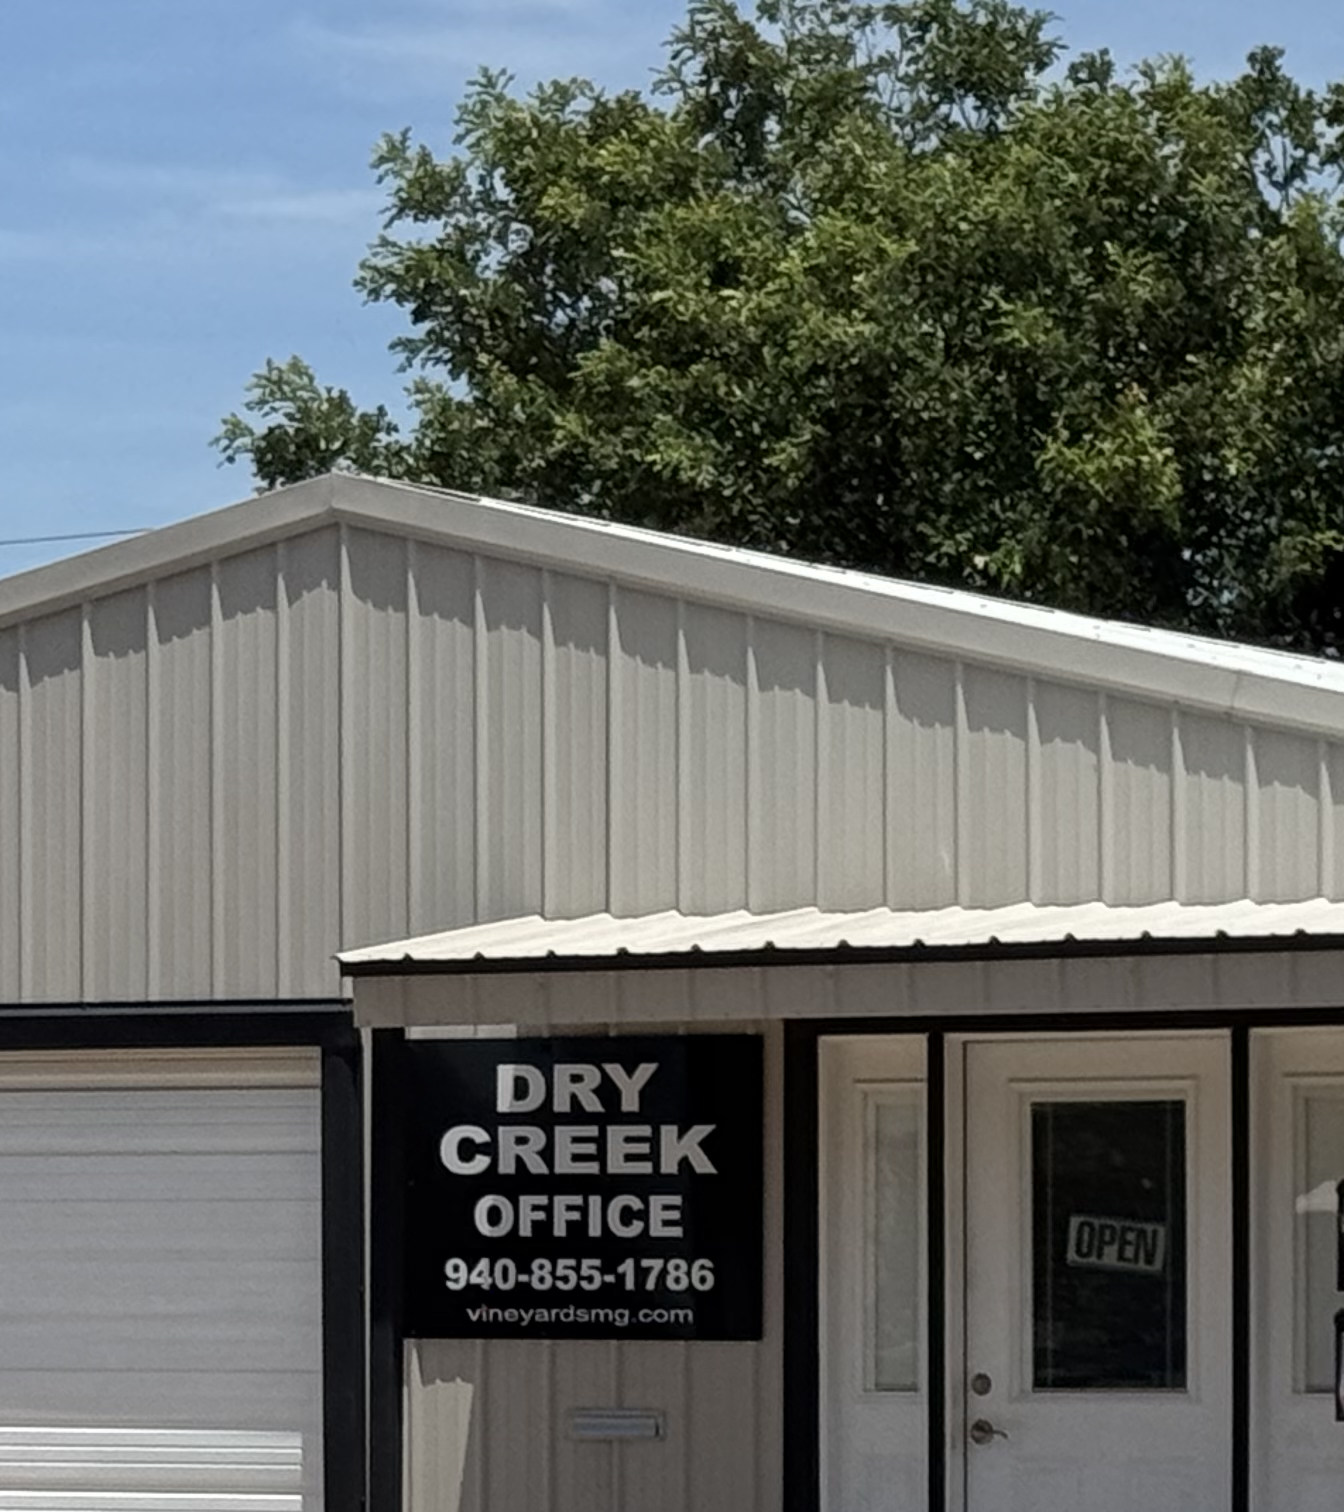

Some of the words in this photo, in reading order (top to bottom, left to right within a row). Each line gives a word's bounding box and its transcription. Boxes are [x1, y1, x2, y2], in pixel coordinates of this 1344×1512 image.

[496, 1062, 659, 1113] DRY
[439, 1123, 719, 1175] CREEK
[473, 1194, 684, 1238] OFFICE
[1074, 1219, 1158, 1267] OPEN
[444, 1257, 715, 1291] 940-855-1786
[466, 1304, 694, 1327] vineyardsmg.com
